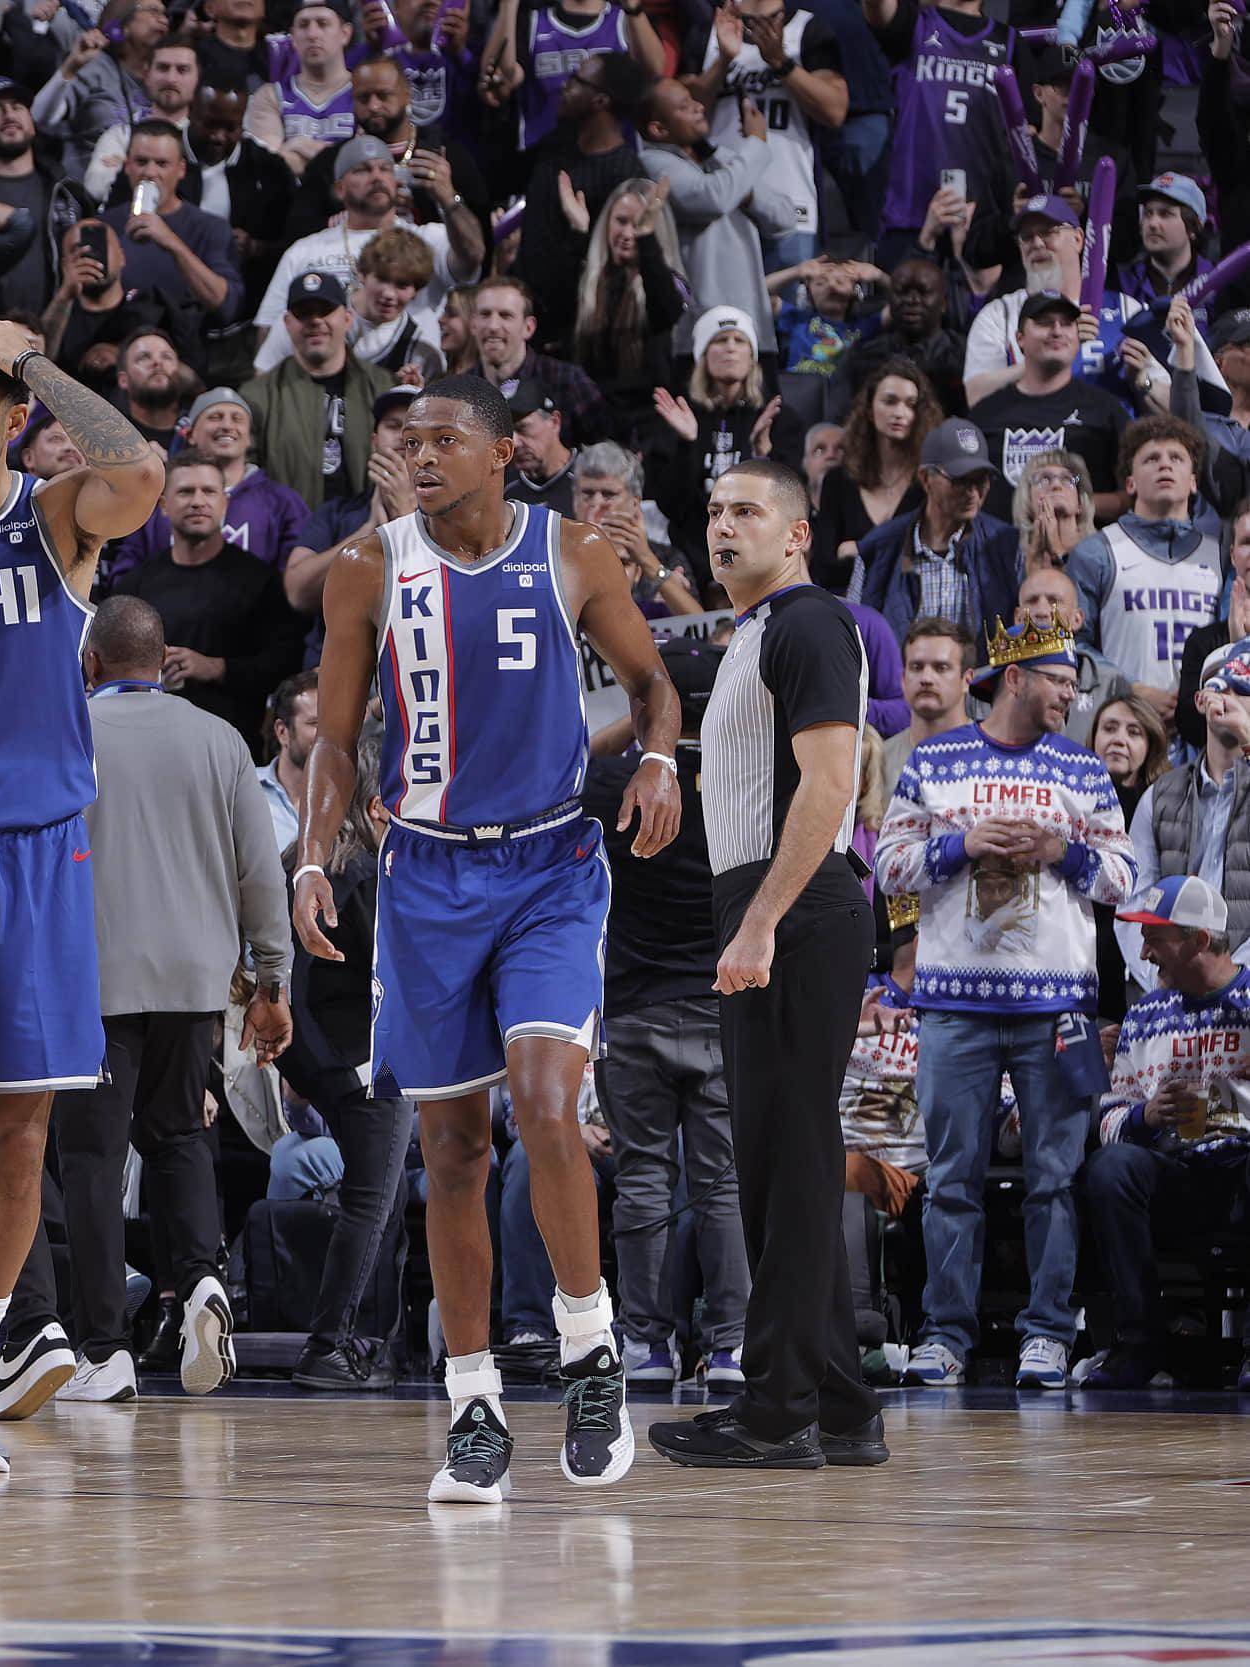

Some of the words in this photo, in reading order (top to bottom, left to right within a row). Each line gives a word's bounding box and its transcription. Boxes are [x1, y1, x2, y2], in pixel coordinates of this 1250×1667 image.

[944, 90, 970, 125] 5
[1081, 340, 1105, 374] 5
[502, 562, 548, 574] dialpad
[496, 608, 537, 670] 5
[973, 782, 1052, 807] LTMFB
[878, 1031, 919, 1062] LTM
[1172, 1031, 1241, 1058] LTMFB
